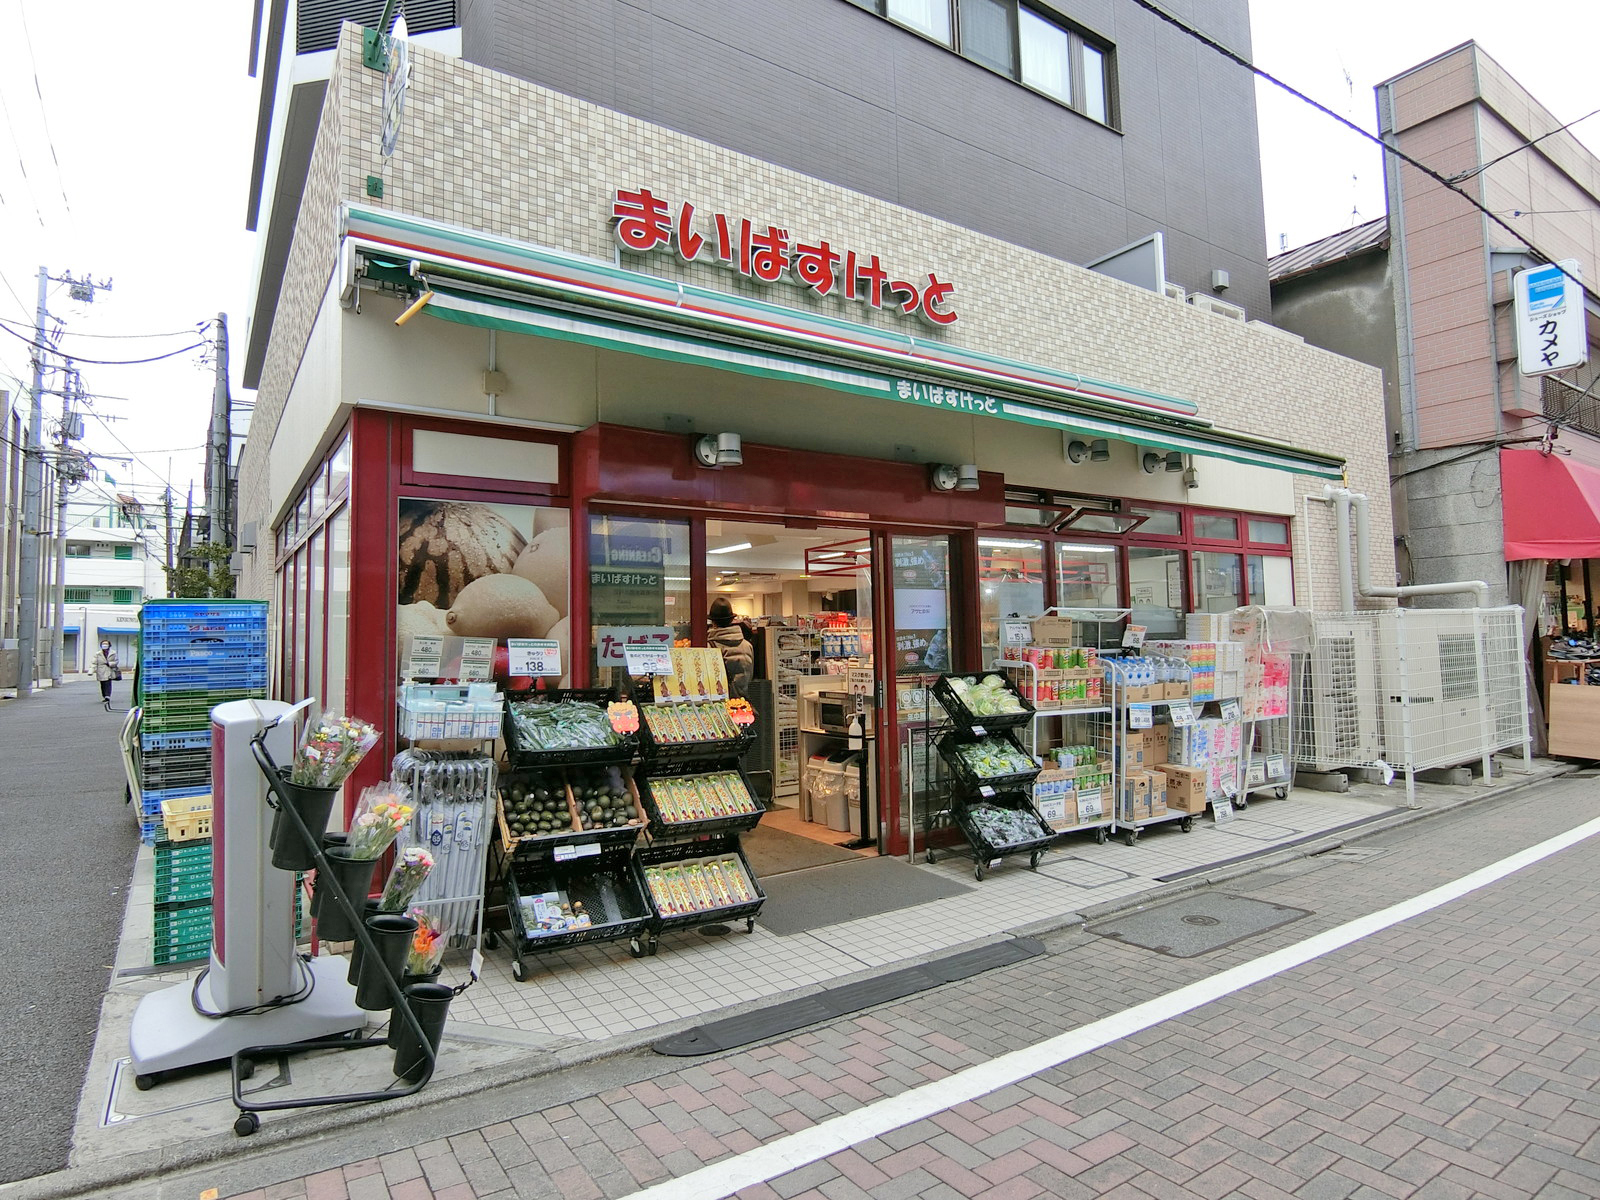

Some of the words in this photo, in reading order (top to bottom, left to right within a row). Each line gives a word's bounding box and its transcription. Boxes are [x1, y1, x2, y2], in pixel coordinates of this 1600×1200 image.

[612, 187, 959, 326] まいばすけっと
[1538, 320, 1560, 367] カメヤ
[896, 380, 998, 414] まいばすけっと
[592, 574, 657, 586] まいばすけっと
[525, 661, 544, 672] 138
[1047, 810, 1057, 818] 69
[1086, 804, 1095, 813] 69
